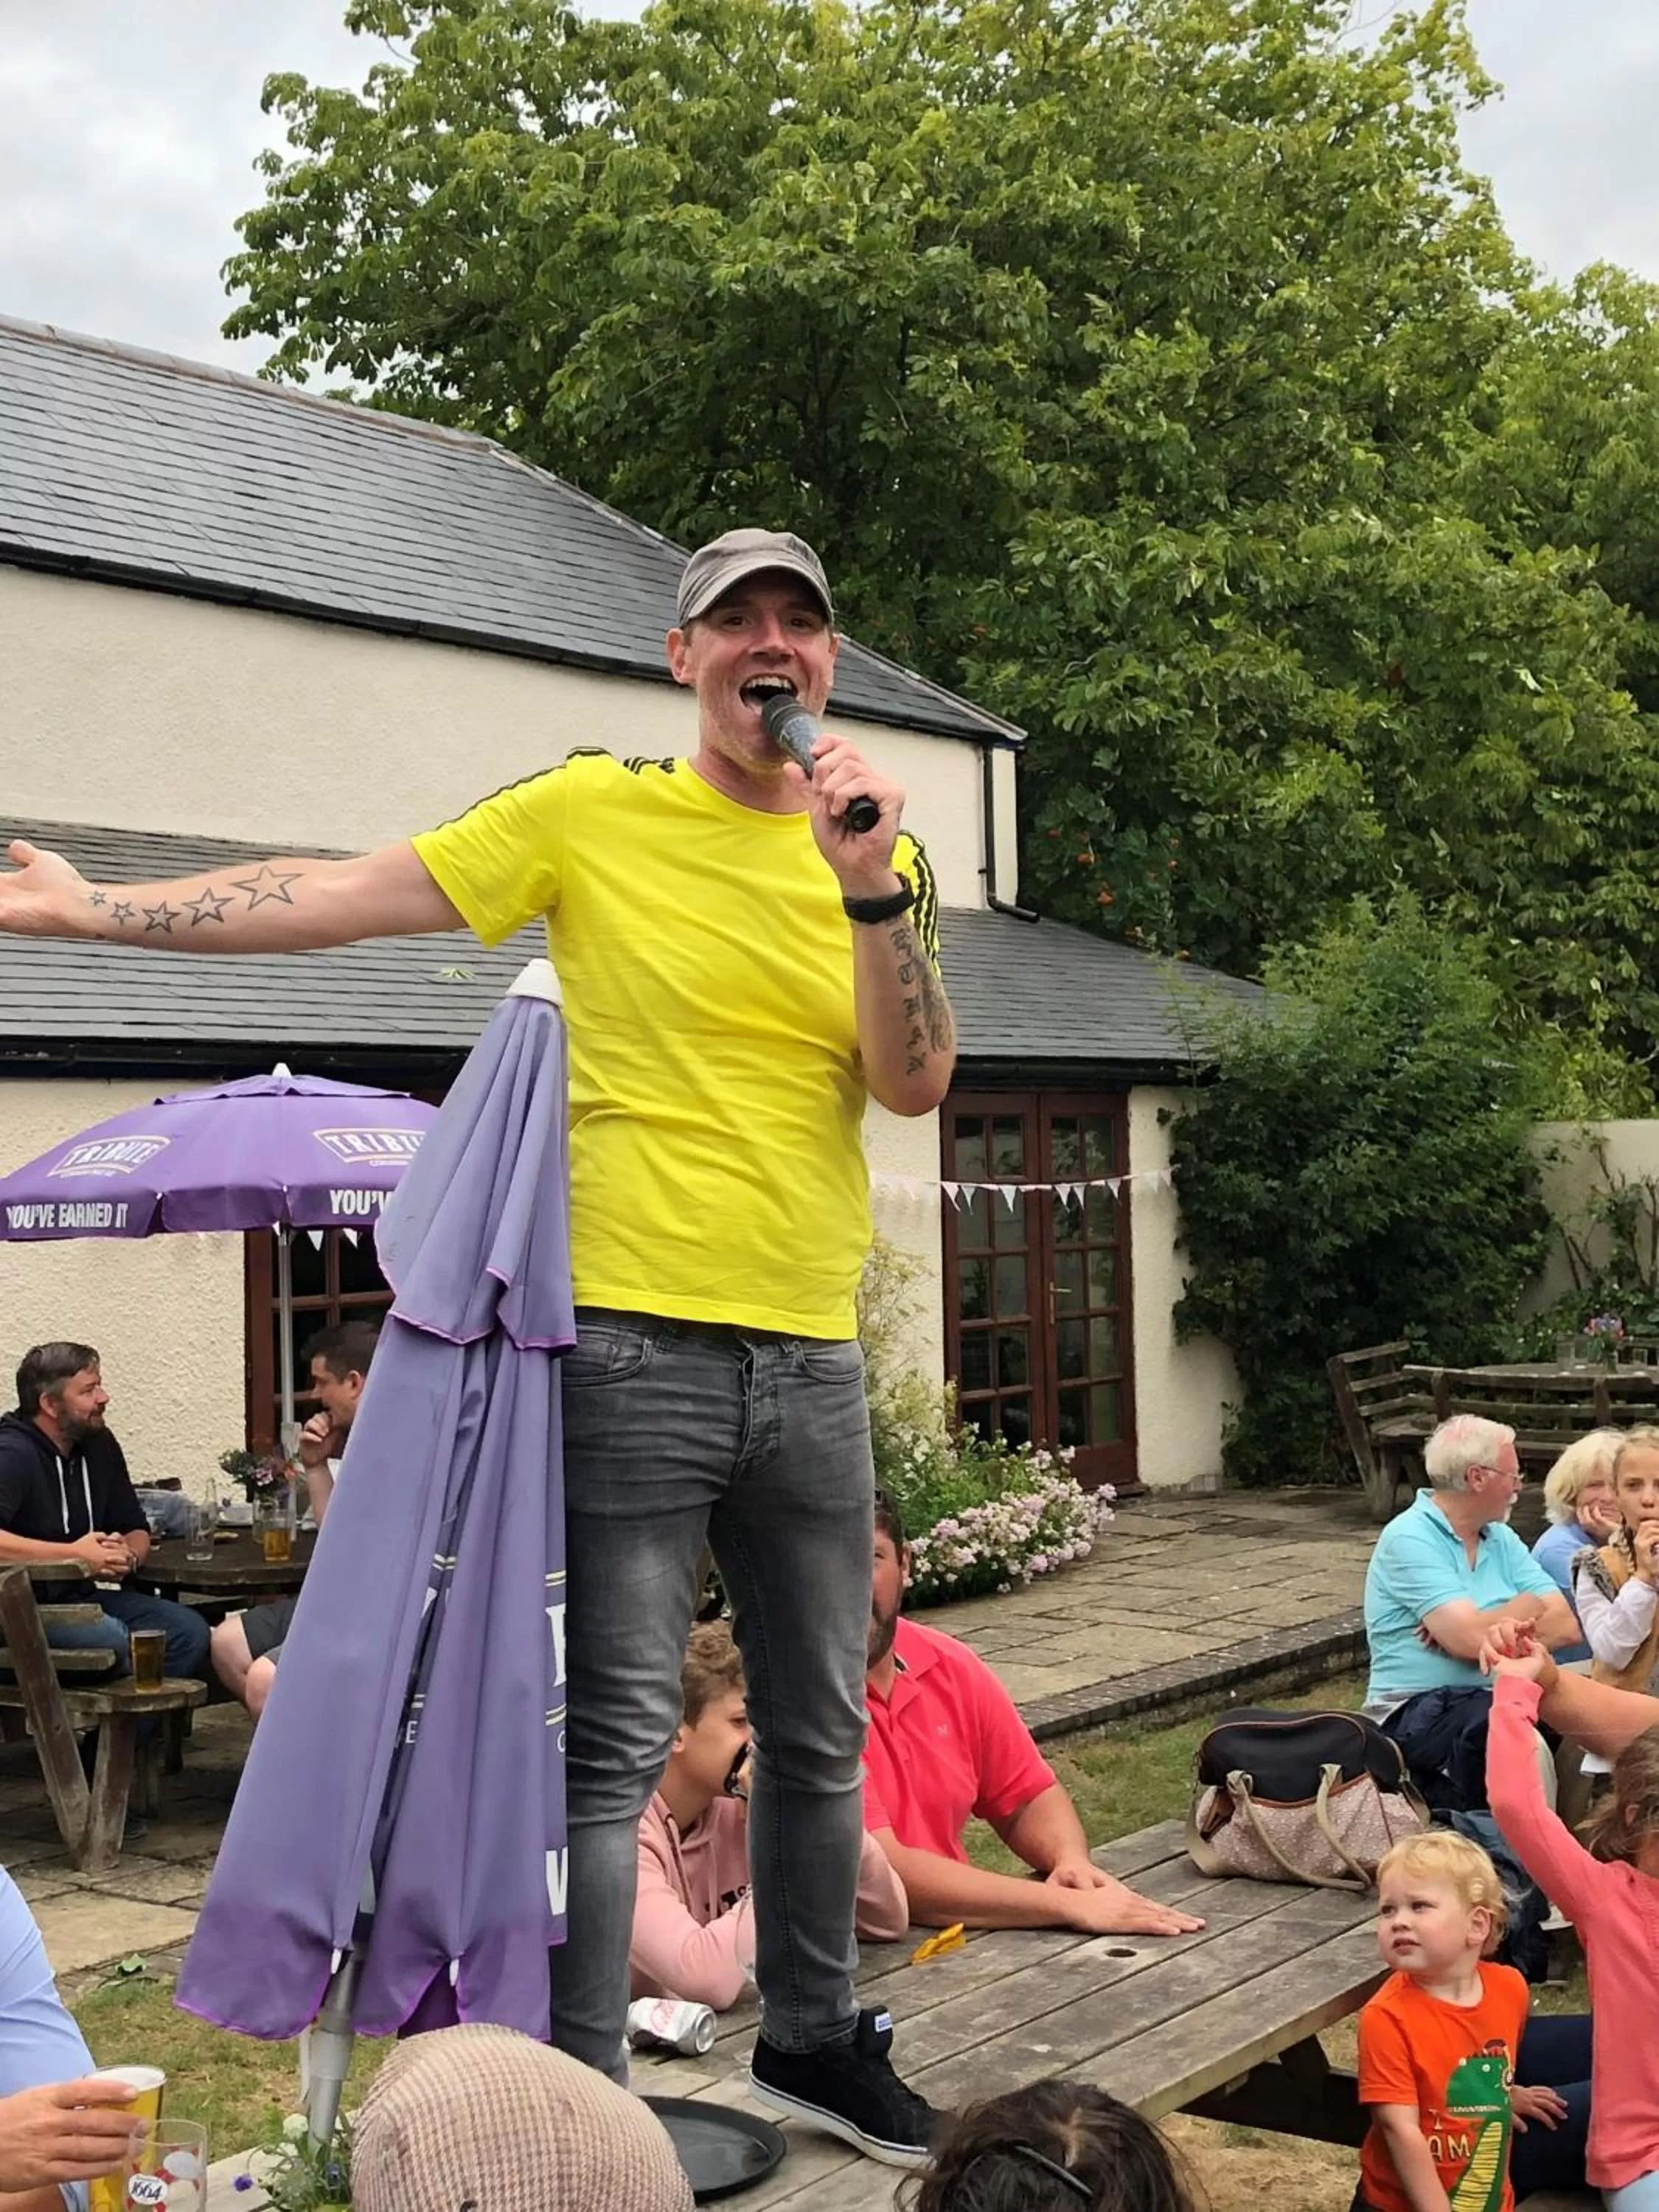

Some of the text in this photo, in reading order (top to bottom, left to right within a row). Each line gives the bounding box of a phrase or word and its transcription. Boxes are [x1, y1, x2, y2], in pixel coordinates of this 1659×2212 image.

[6, 1203, 129, 1229] YOU'VE EARNED IT
